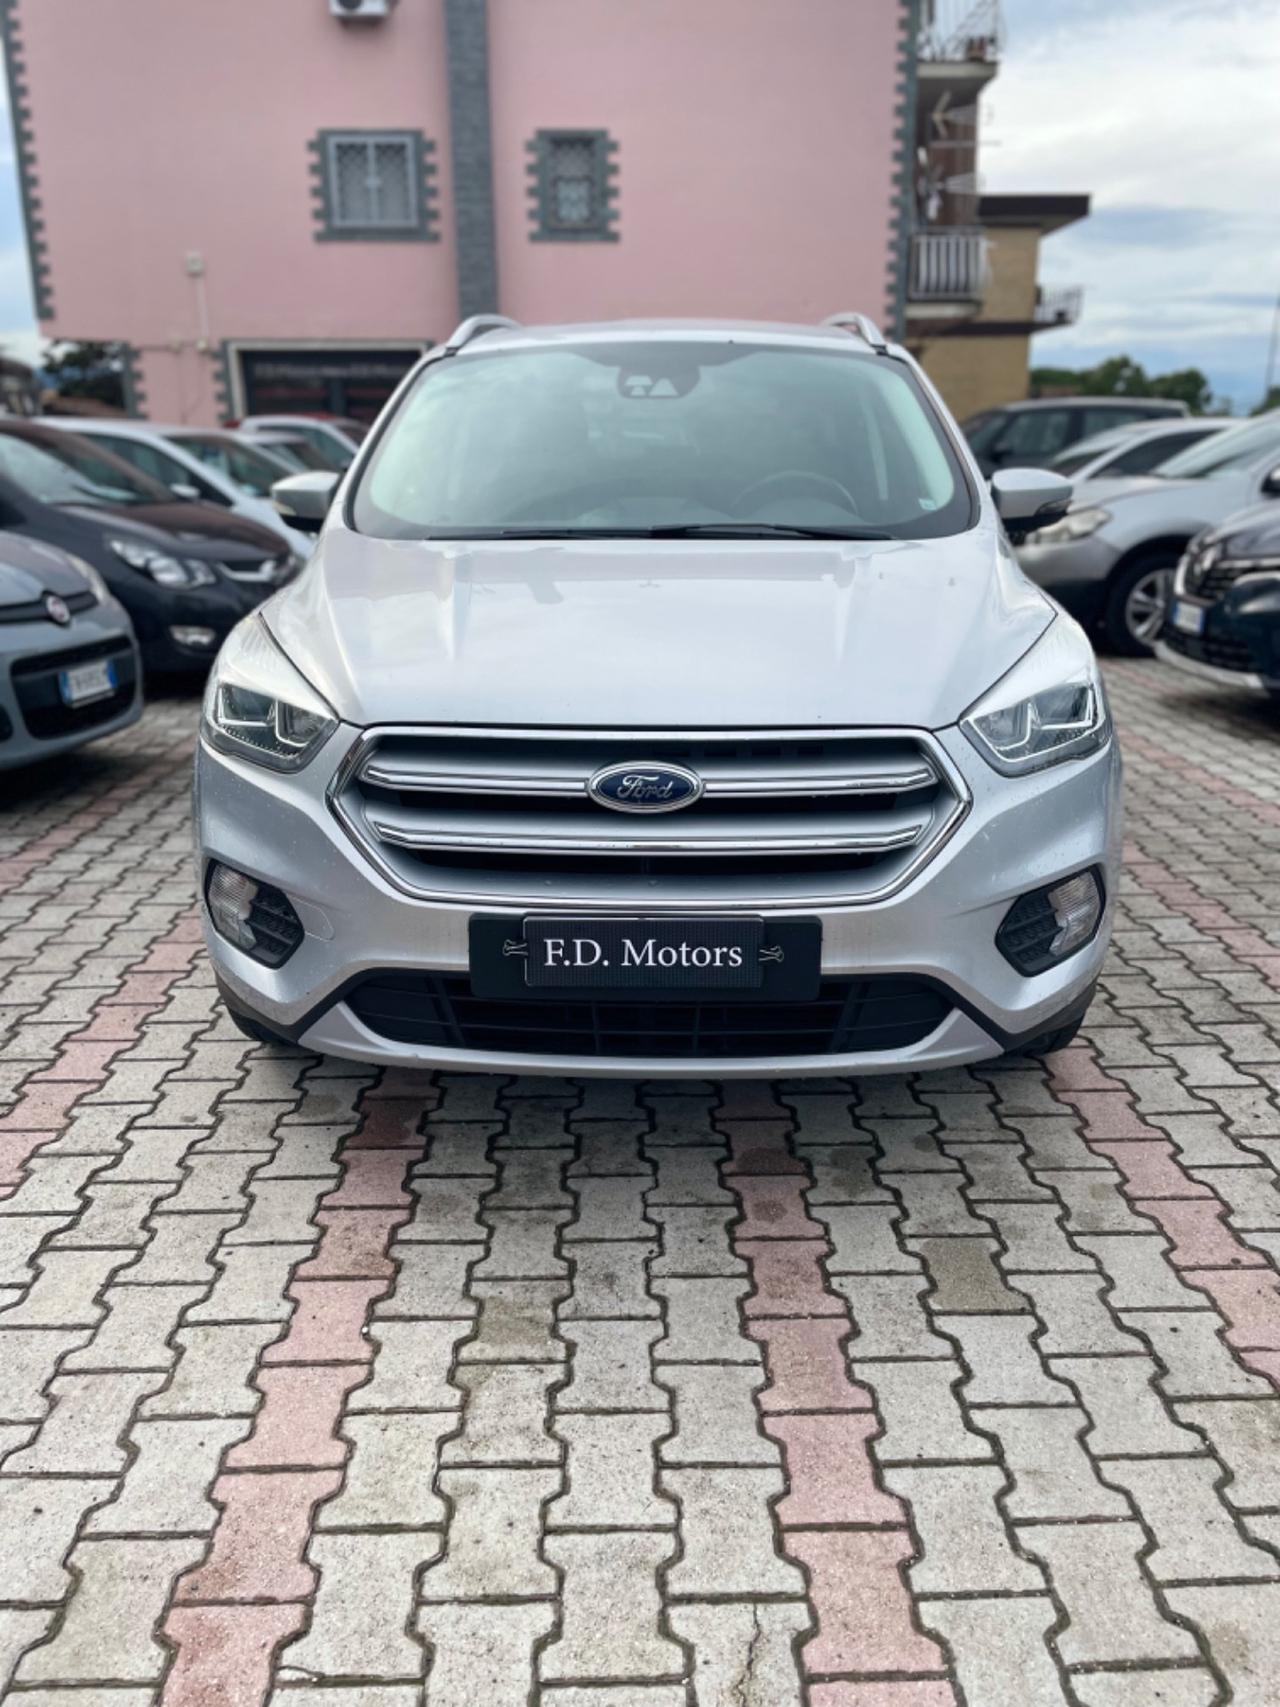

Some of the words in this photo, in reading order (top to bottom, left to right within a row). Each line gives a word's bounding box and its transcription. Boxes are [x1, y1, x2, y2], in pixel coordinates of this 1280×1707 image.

[618, 774, 673, 799] Ford
[543, 938, 610, 967] F.D.
[621, 938, 743, 967] Motors
